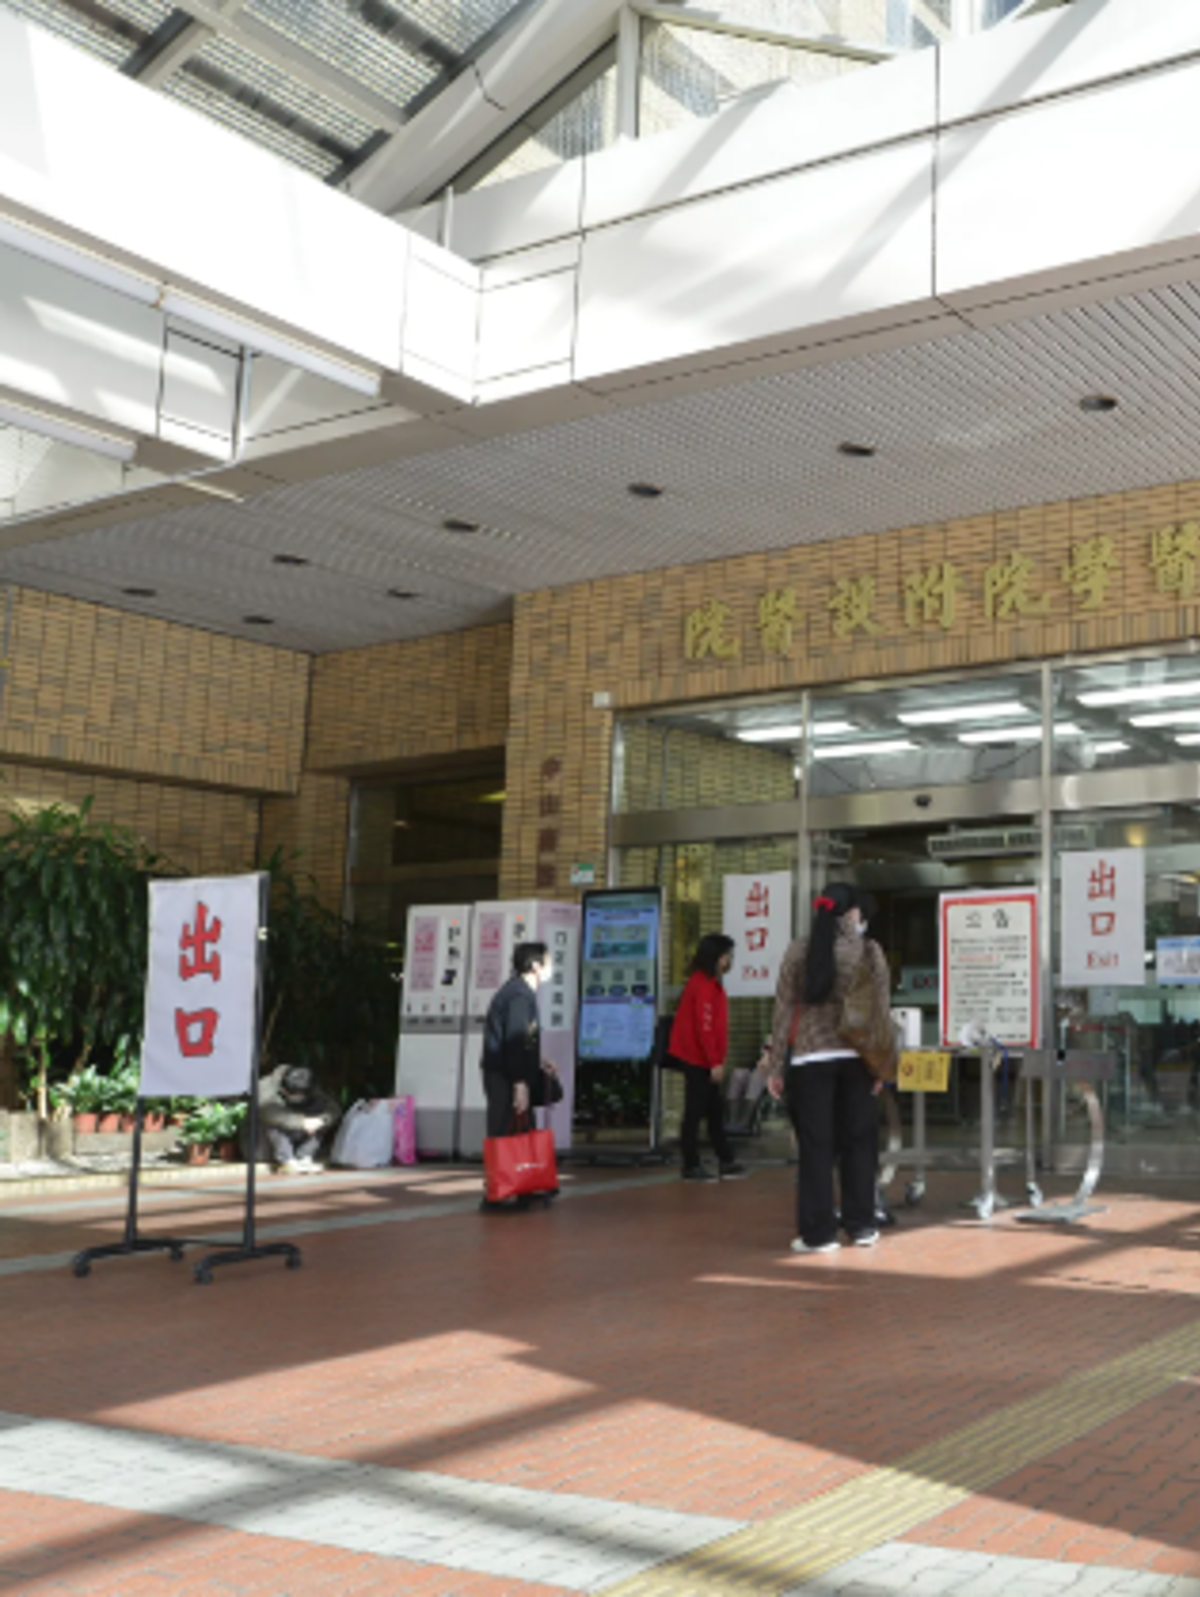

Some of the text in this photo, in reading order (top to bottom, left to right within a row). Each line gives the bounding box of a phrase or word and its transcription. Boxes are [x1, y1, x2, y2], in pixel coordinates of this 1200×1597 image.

[745, 882, 770, 951] 出口
[1088, 860, 1116, 936] 出口
[175, 901, 222, 1057] 出口
[1087, 952, 1119, 969] Exit
